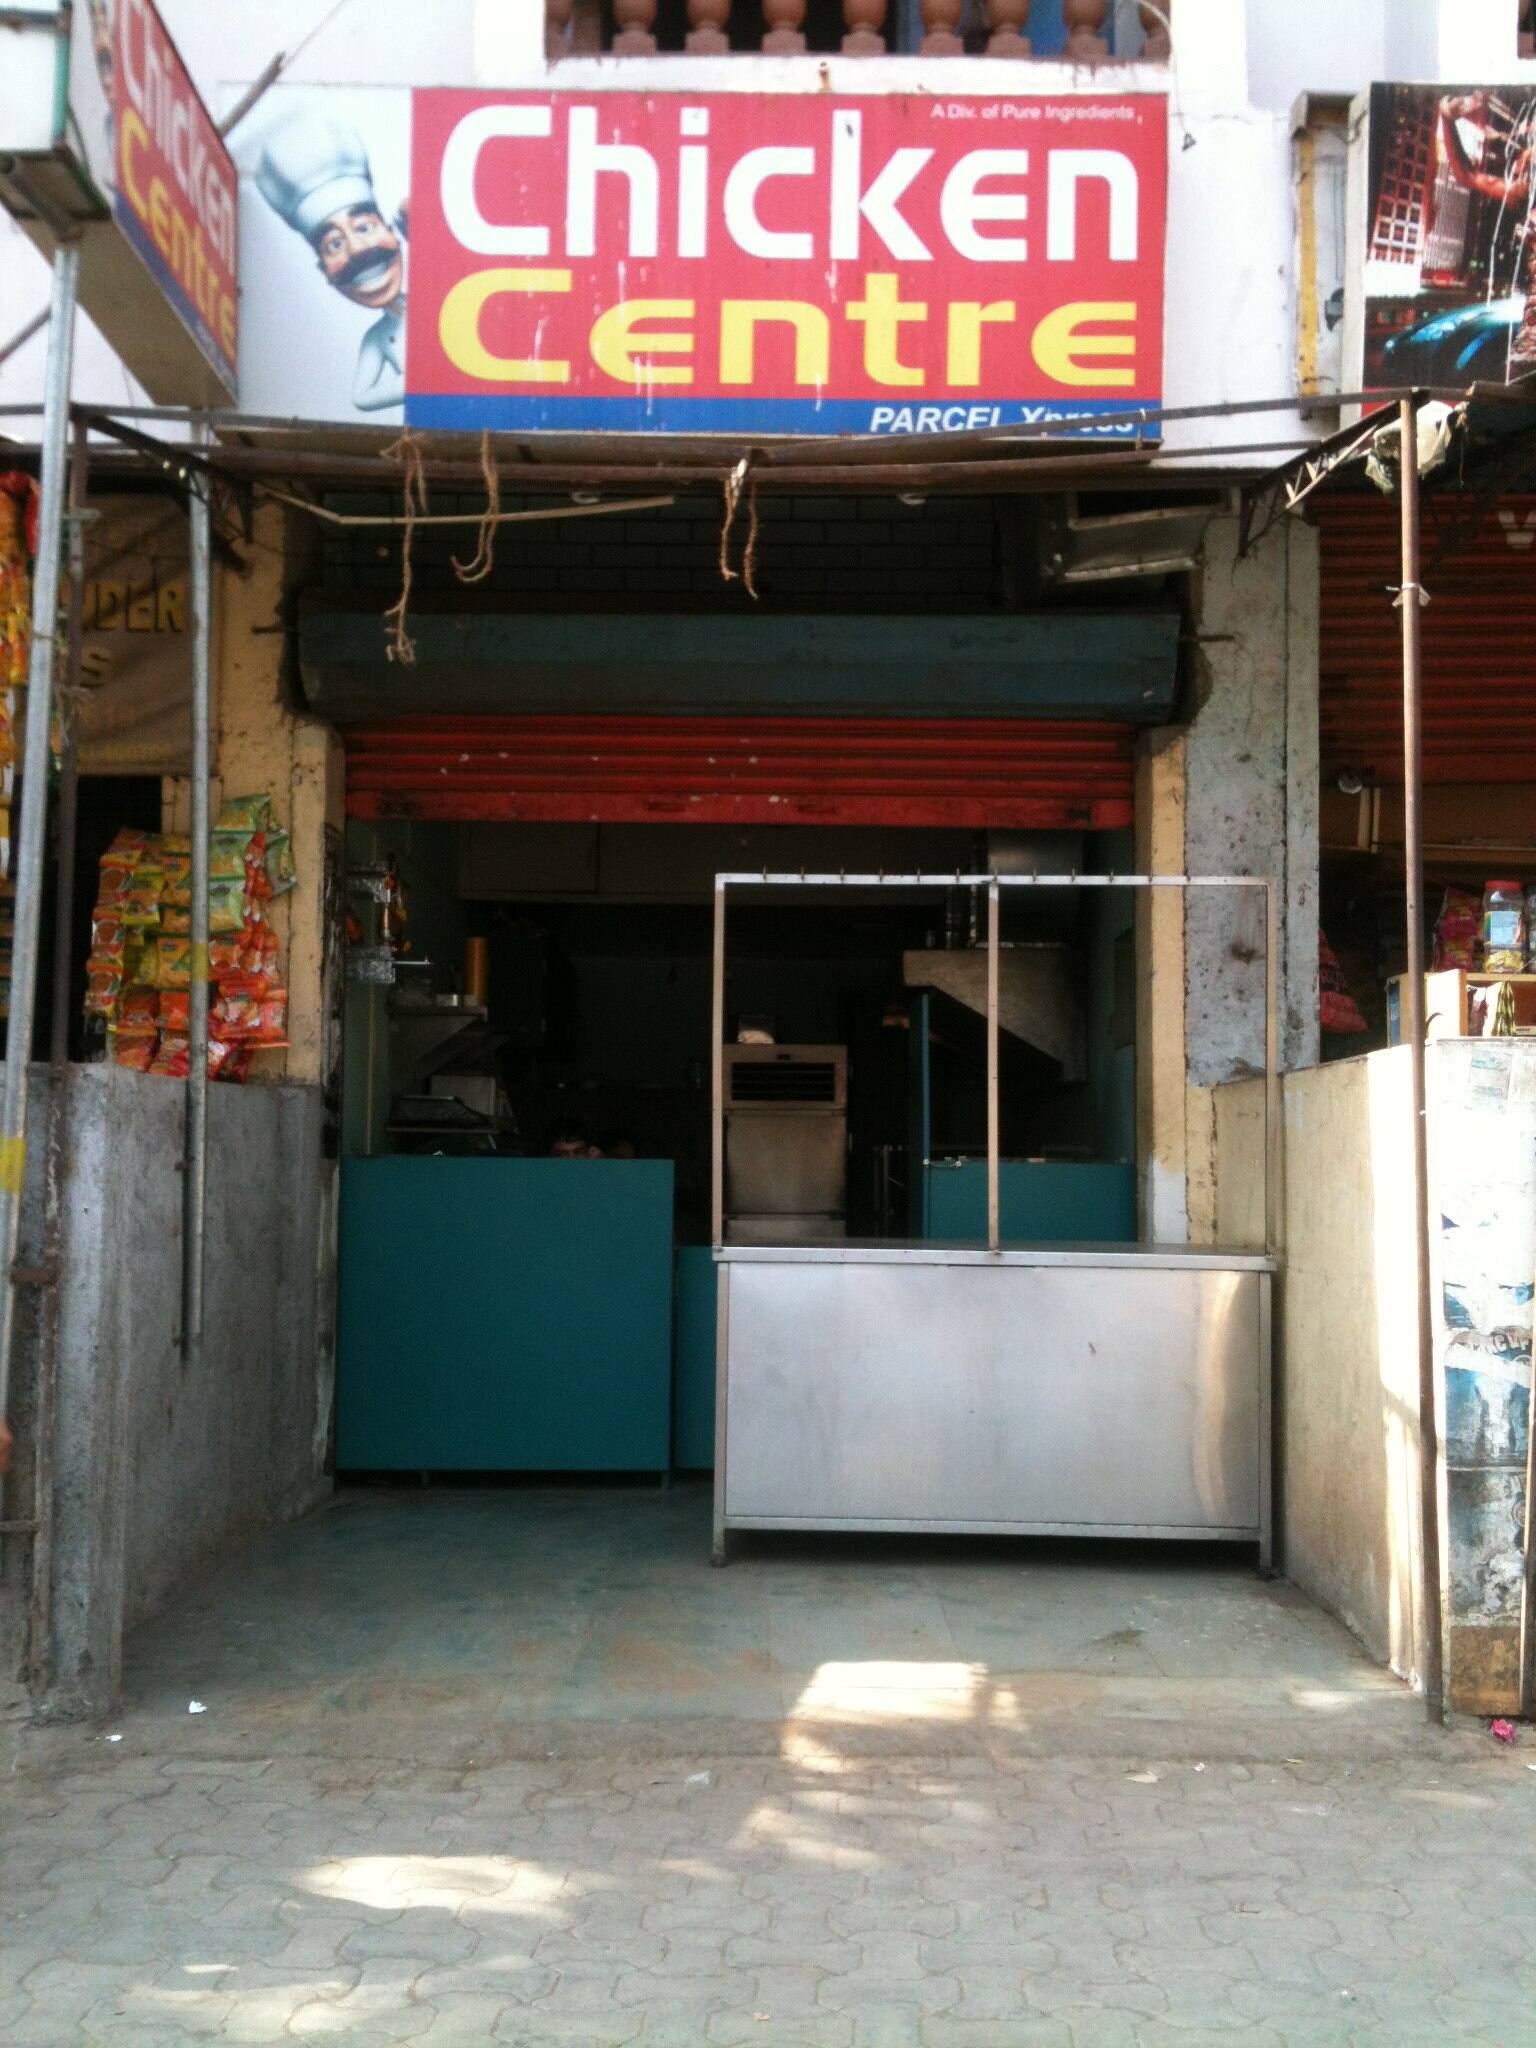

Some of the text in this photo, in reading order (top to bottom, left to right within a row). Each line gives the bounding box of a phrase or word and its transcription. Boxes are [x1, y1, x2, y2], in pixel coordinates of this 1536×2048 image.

[931, 103, 945, 119] A
[981, 103, 999, 119] of
[1002, 103, 1041, 119] Pure
[440, 104, 1139, 262] Chicken
[438, 268, 1137, 387] Centre
[1021, 407, 1134, 432] Xpr
